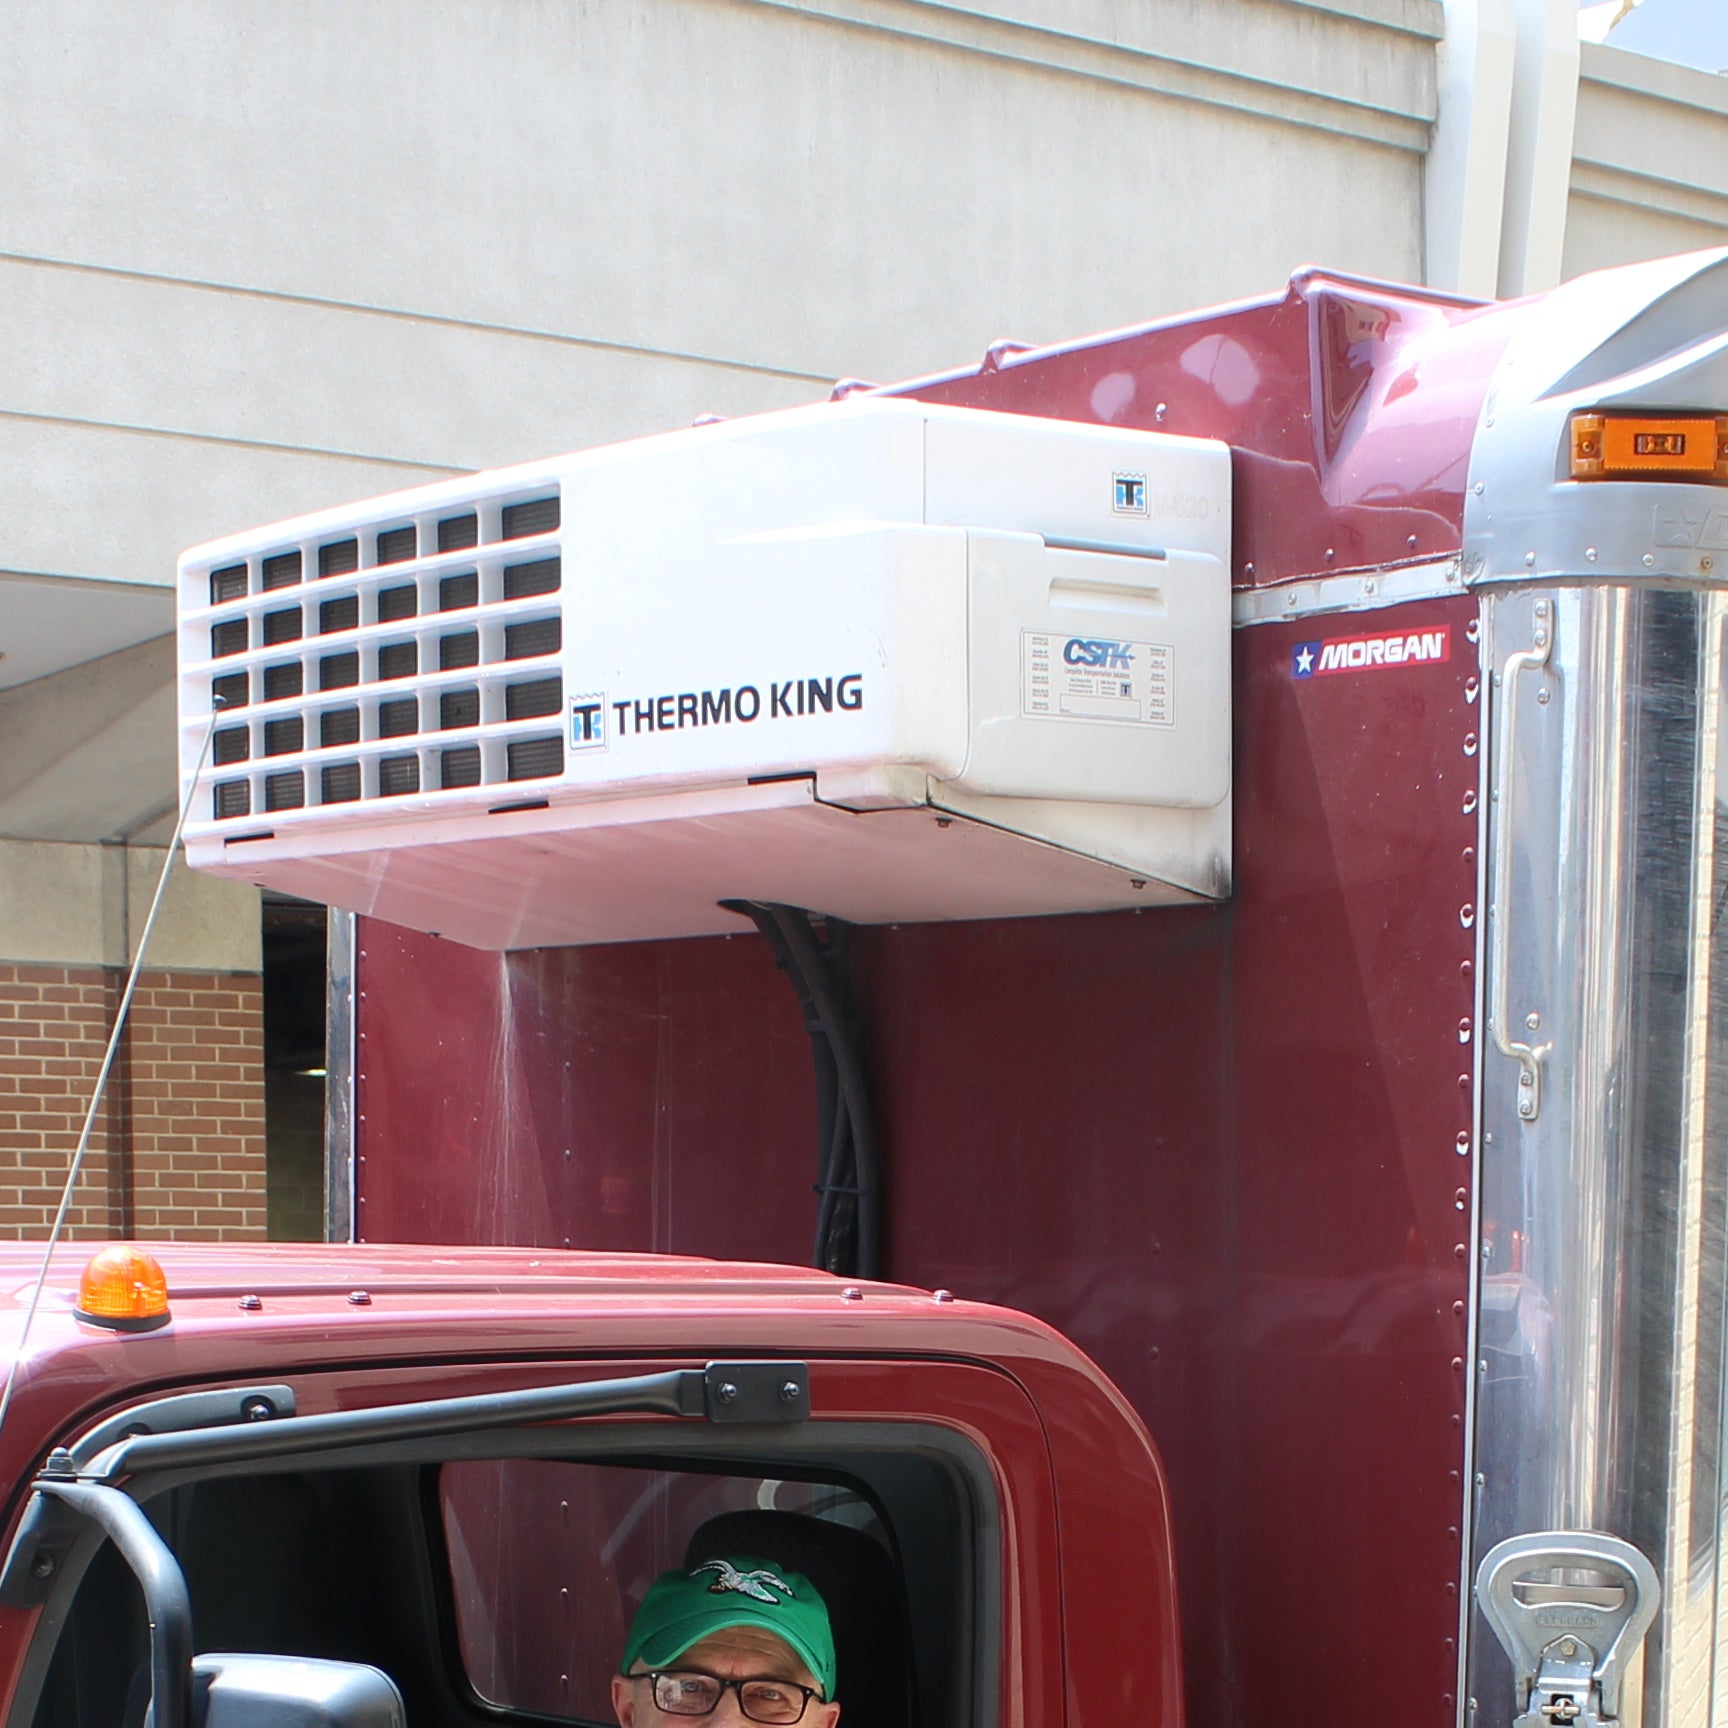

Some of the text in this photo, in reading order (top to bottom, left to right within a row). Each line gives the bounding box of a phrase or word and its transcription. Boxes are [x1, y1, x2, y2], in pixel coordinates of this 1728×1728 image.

[1318, 632, 1442, 670] MORGAN
[612, 674, 864, 736] THERMO KING
